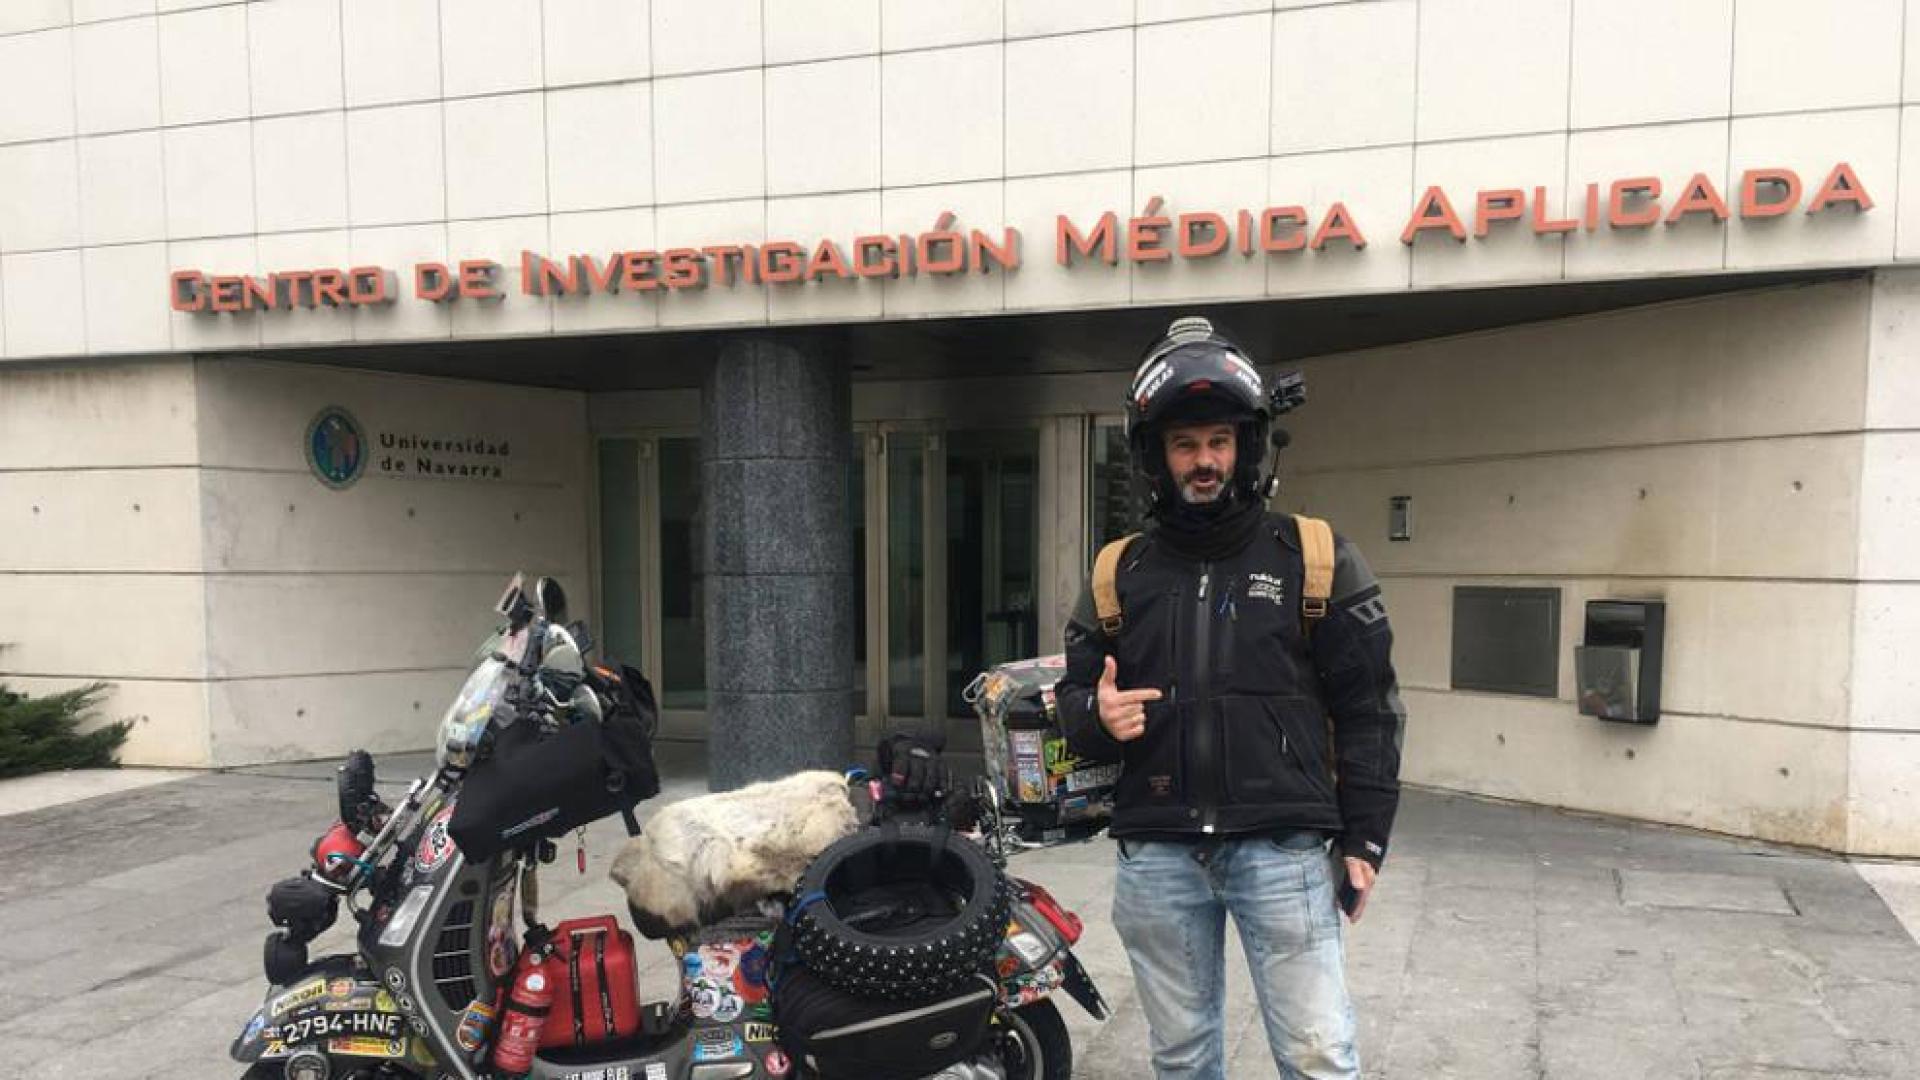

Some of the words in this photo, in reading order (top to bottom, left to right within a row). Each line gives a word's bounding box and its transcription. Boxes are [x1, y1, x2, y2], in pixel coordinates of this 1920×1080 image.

[170, 265, 387, 312] CENTRO
[415, 258, 501, 301] DE
[520, 211, 1020, 296] INVESTIGACIÓN
[1056, 195, 1367, 267] MÉDICA
[1400, 162, 1874, 245] APLICADA
[379, 432, 510, 456] Universidad
[381, 456, 406, 472] de
[416, 458, 502, 479] Navarra
